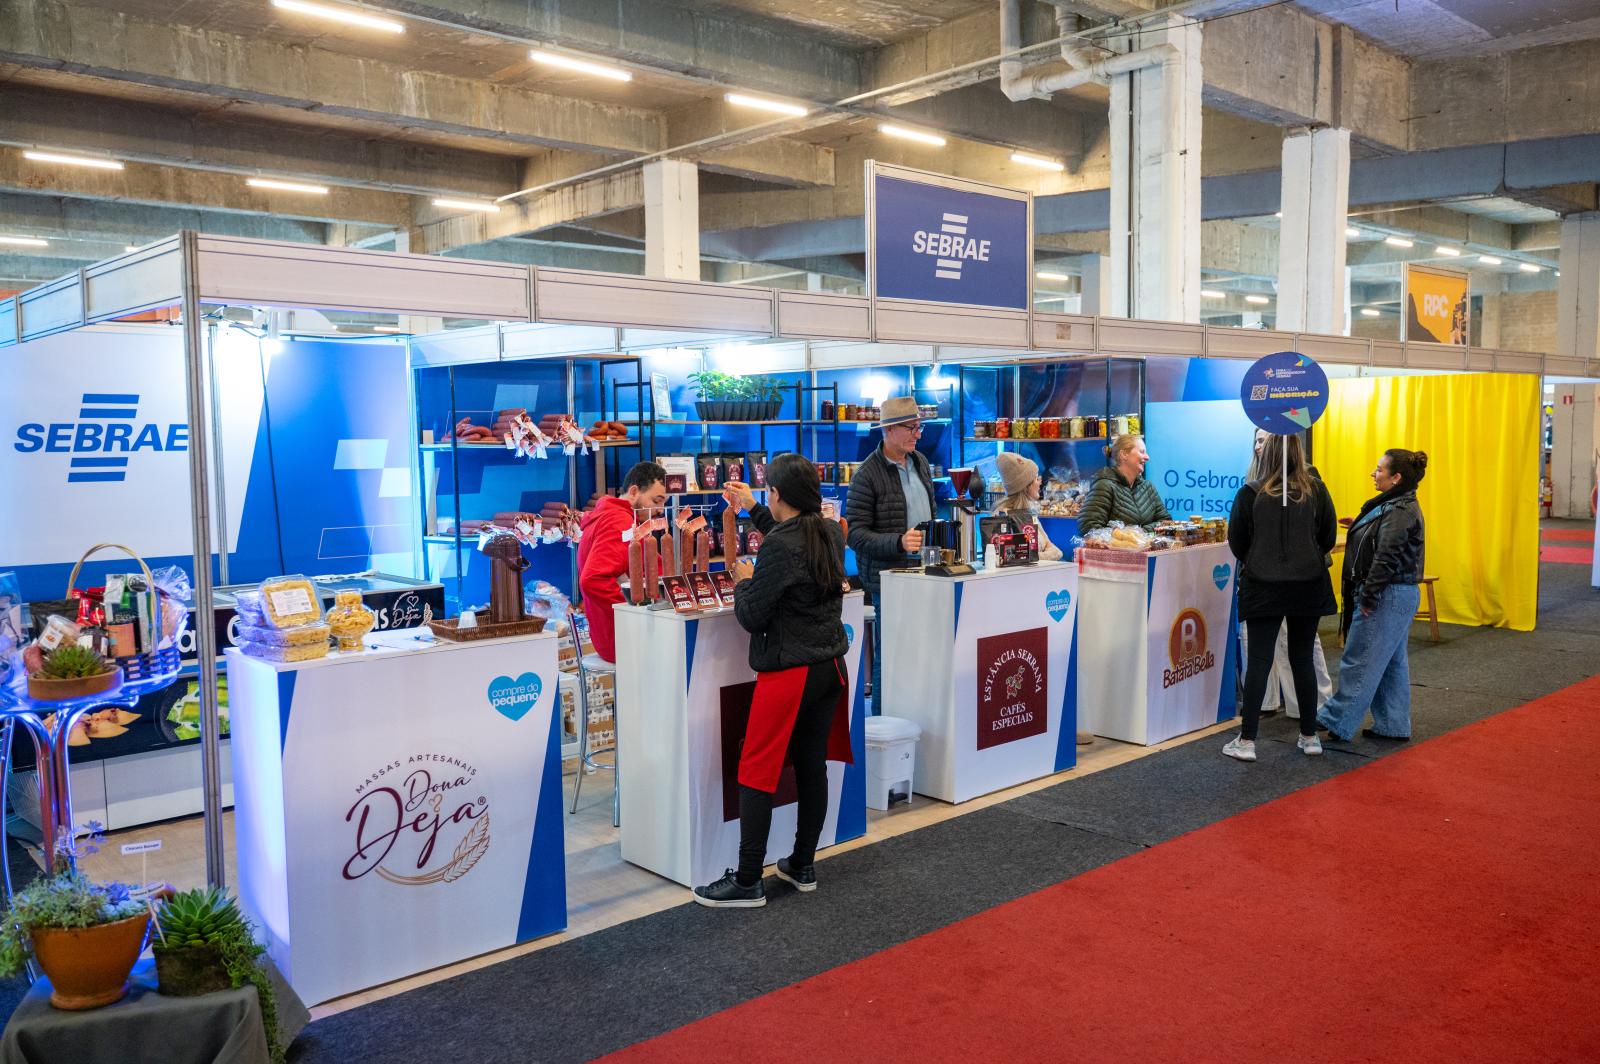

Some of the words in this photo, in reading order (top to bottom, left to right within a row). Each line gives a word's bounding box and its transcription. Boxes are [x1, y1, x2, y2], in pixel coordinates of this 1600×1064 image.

[912, 230, 991, 262] SEBRAE
[1423, 294, 1449, 318] RPC
[14, 423, 188, 453] SEBRAE
[1164, 469, 1179, 488] O
[1164, 497, 1194, 512] pra
[1017, 648, 1043, 693] SERRANA
[1163, 661, 1193, 689] Batata
[1193, 651, 1215, 675] Bella
[491, 686, 525, 698] compre
[526, 682, 539, 692] do
[492, 692, 539, 707] pequeno
[1000, 701, 1026, 717] CAFÉS
[992, 712, 1034, 731] ESPECIAIS
[355, 760, 401, 794] MASSAS
[408, 754, 477, 776] ARTESANAIS
[403, 769, 472, 812] Dona
